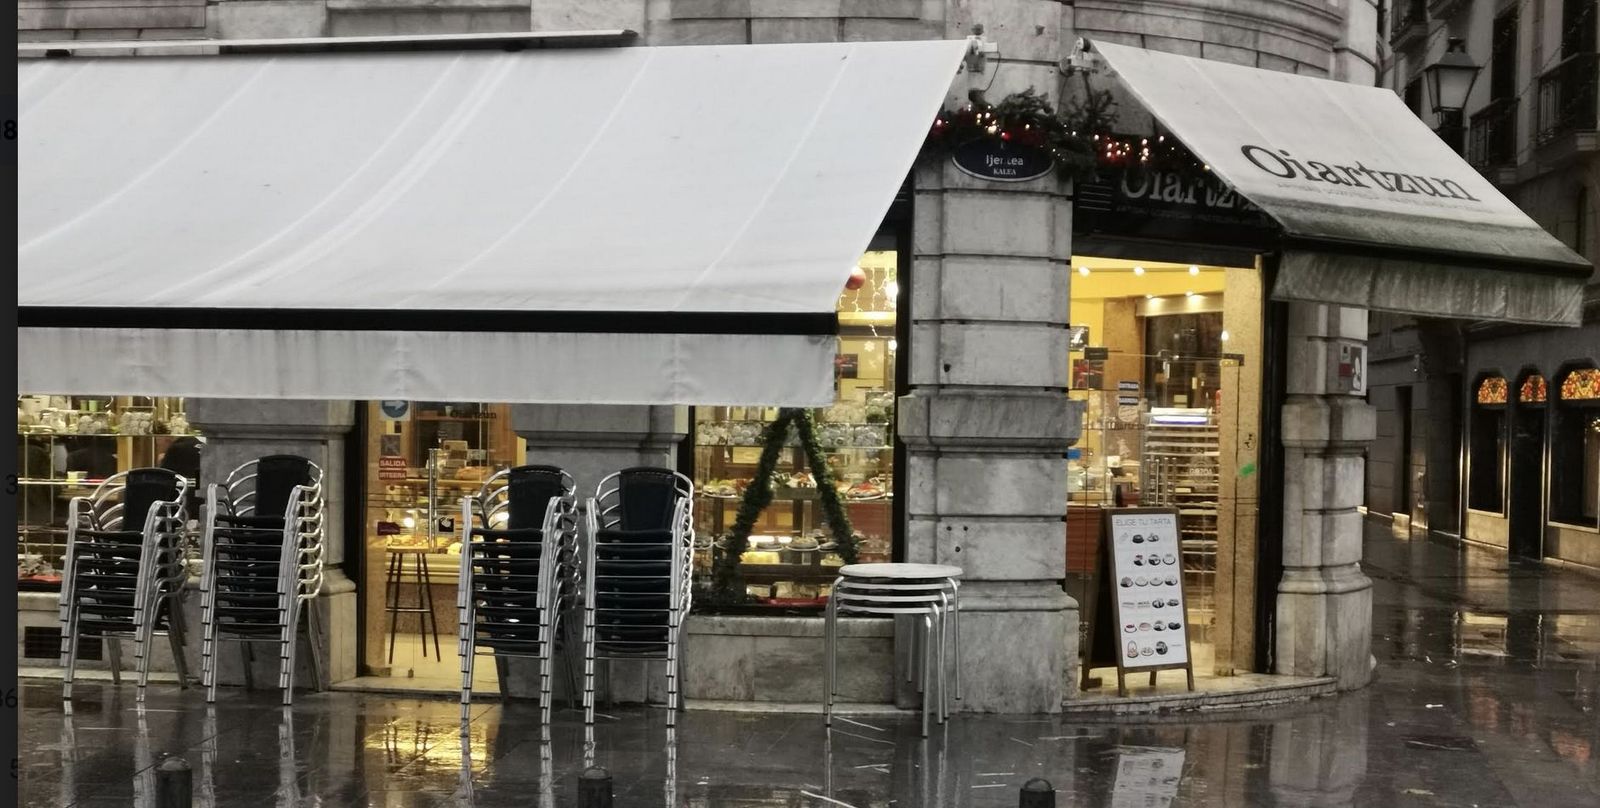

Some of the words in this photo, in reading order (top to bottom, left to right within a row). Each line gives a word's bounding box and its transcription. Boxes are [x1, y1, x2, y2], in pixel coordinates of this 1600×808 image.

[993, 167, 1017, 176] KALEA
[1240, 144, 1481, 202] Oiartzun
[1138, 518, 1149, 526] TU
[1150, 518, 1172, 526] TARTA
